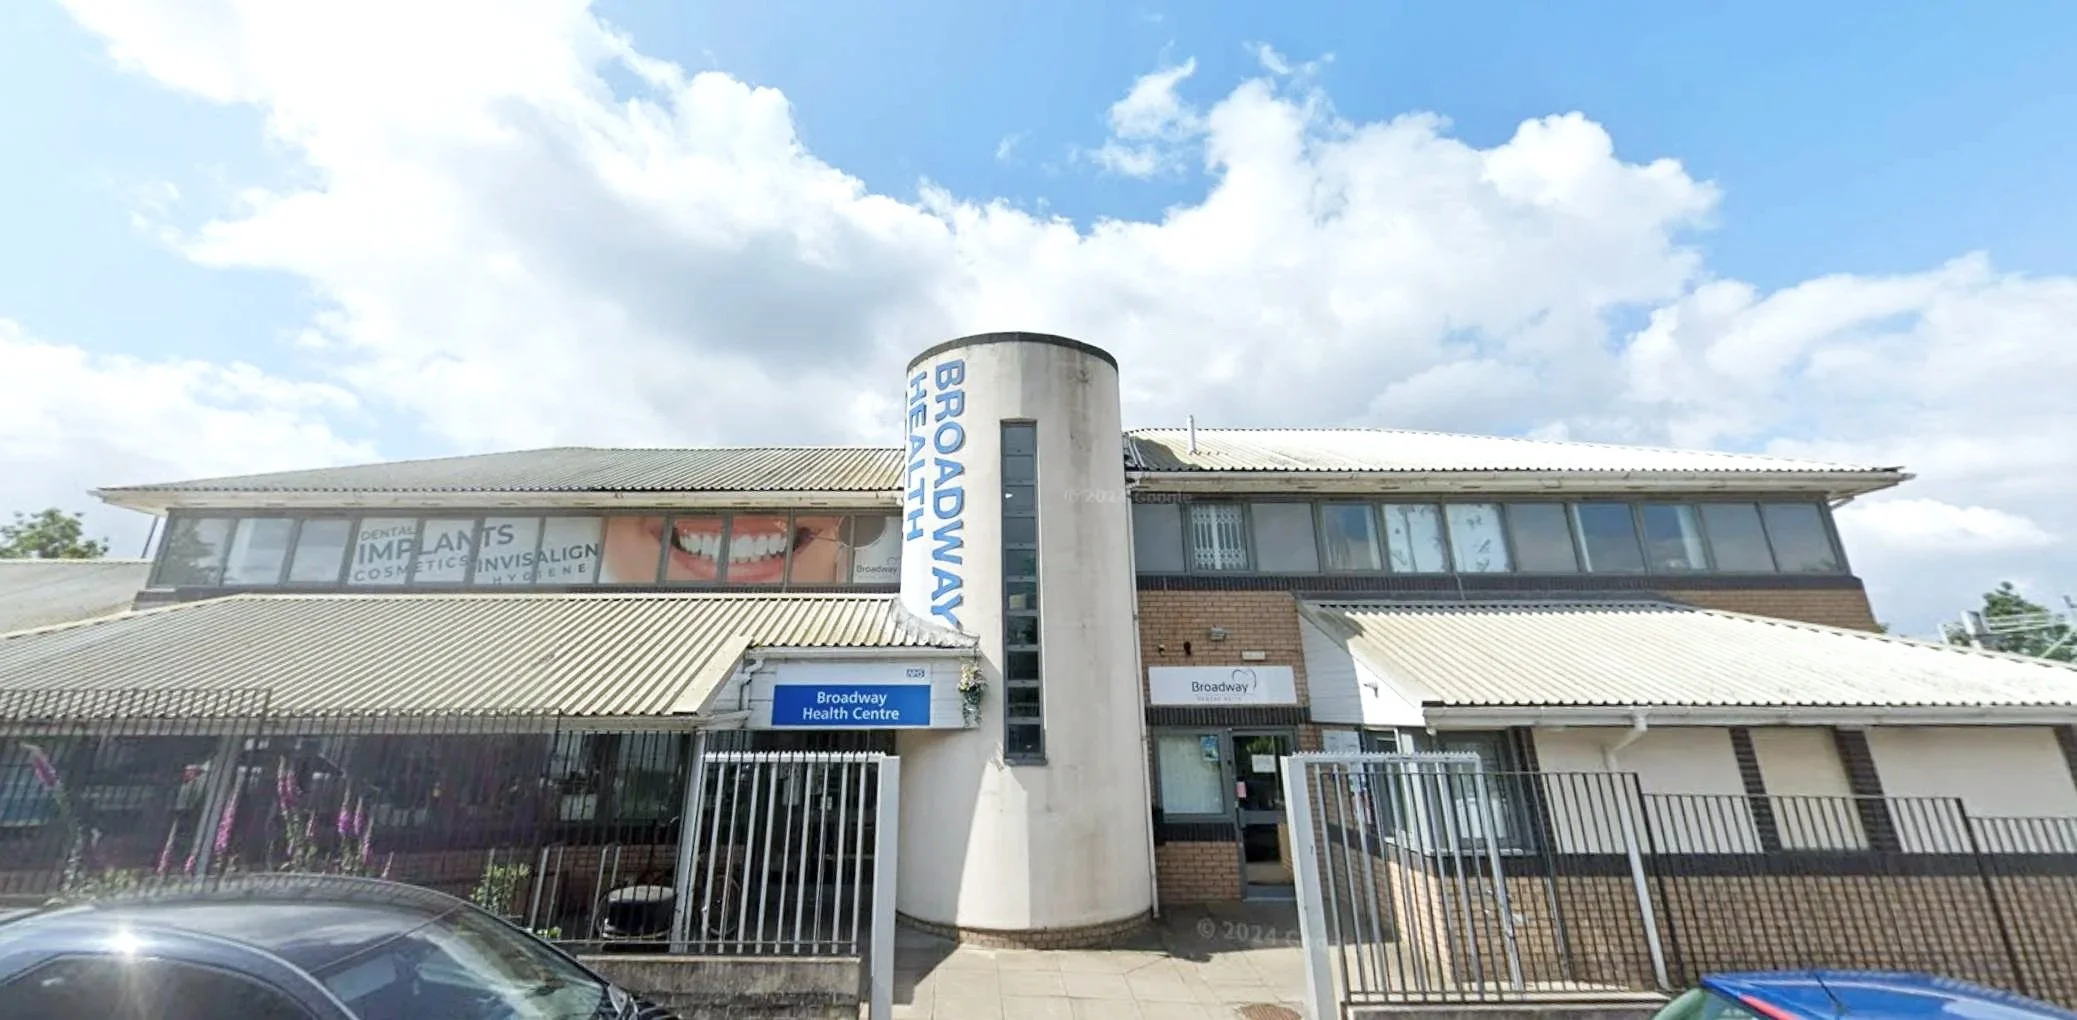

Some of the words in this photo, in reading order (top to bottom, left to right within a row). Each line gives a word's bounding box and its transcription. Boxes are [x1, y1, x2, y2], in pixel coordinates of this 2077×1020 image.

[907, 370, 928, 542] HEALTH
[930, 359, 966, 632] BROADWAY
[358, 523, 515, 565] IMPLANTS
[360, 525, 415, 542] DENTAL
[353, 555, 471, 582] COSMETICS
[477, 543, 599, 573] INVISALIGN
[905, 668, 926, 679] NHS
[816, 691, 888, 706] Broadway
[1191, 681, 1249, 694] Broadway
[802, 707, 848, 721] Health
[852, 706, 900, 721] Centre
